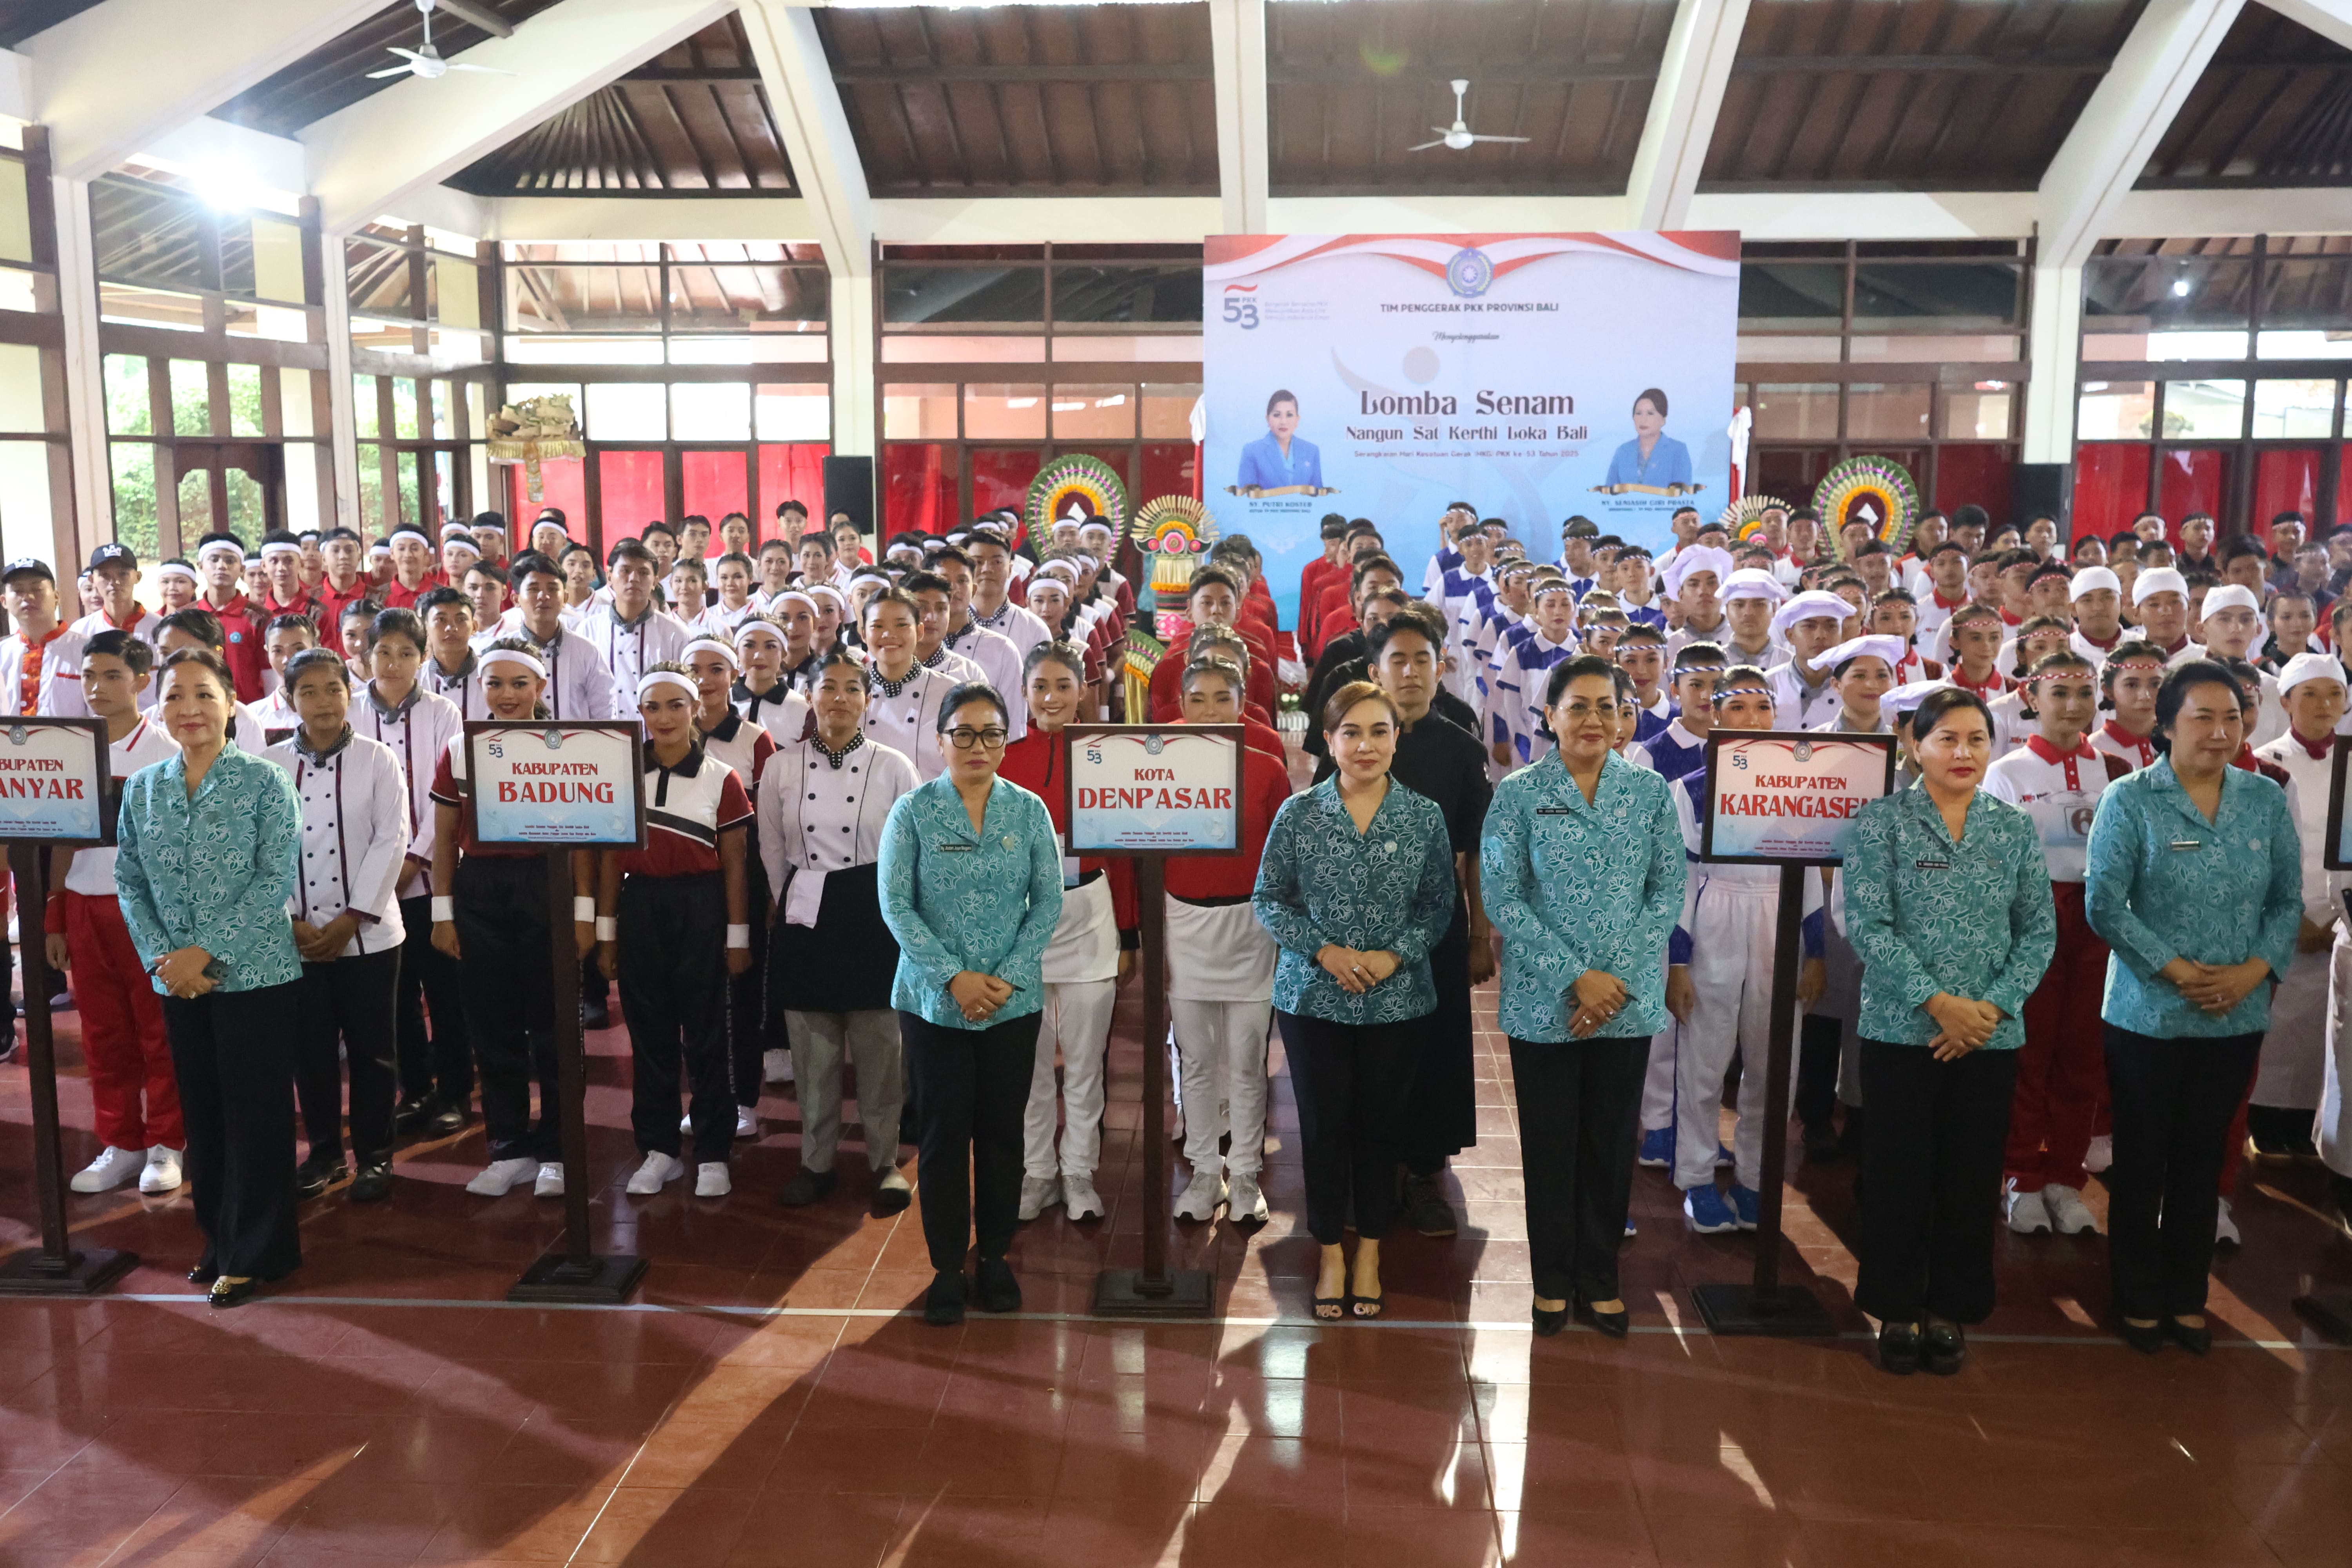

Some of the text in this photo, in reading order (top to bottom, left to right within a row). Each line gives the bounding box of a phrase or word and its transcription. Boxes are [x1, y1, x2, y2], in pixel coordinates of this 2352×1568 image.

[1223, 297, 1259, 330] 53
[1381, 304, 1398, 312] TIM
[1401, 304, 1461, 312] PENGGERAK
[1487, 303, 1534, 312] PROVINSI
[1537, 303, 1559, 311] BALI
[1361, 390, 1574, 415] Lomba Senam
[1346, 425, 1588, 442] Nangun Sat Kerthi Loka Bali
[488, 744, 503, 758] 53
[1087, 750, 1102, 764] 53
[512, 762, 598, 775] KABUPATEN
[1732, 755, 1748, 769] 53
[1134, 769, 1175, 781] KOTA
[1755, 775, 1847, 790] KABUPATEN
[498, 781, 614, 804] BADUNG
[1078, 788, 1232, 809] DENPASAR
